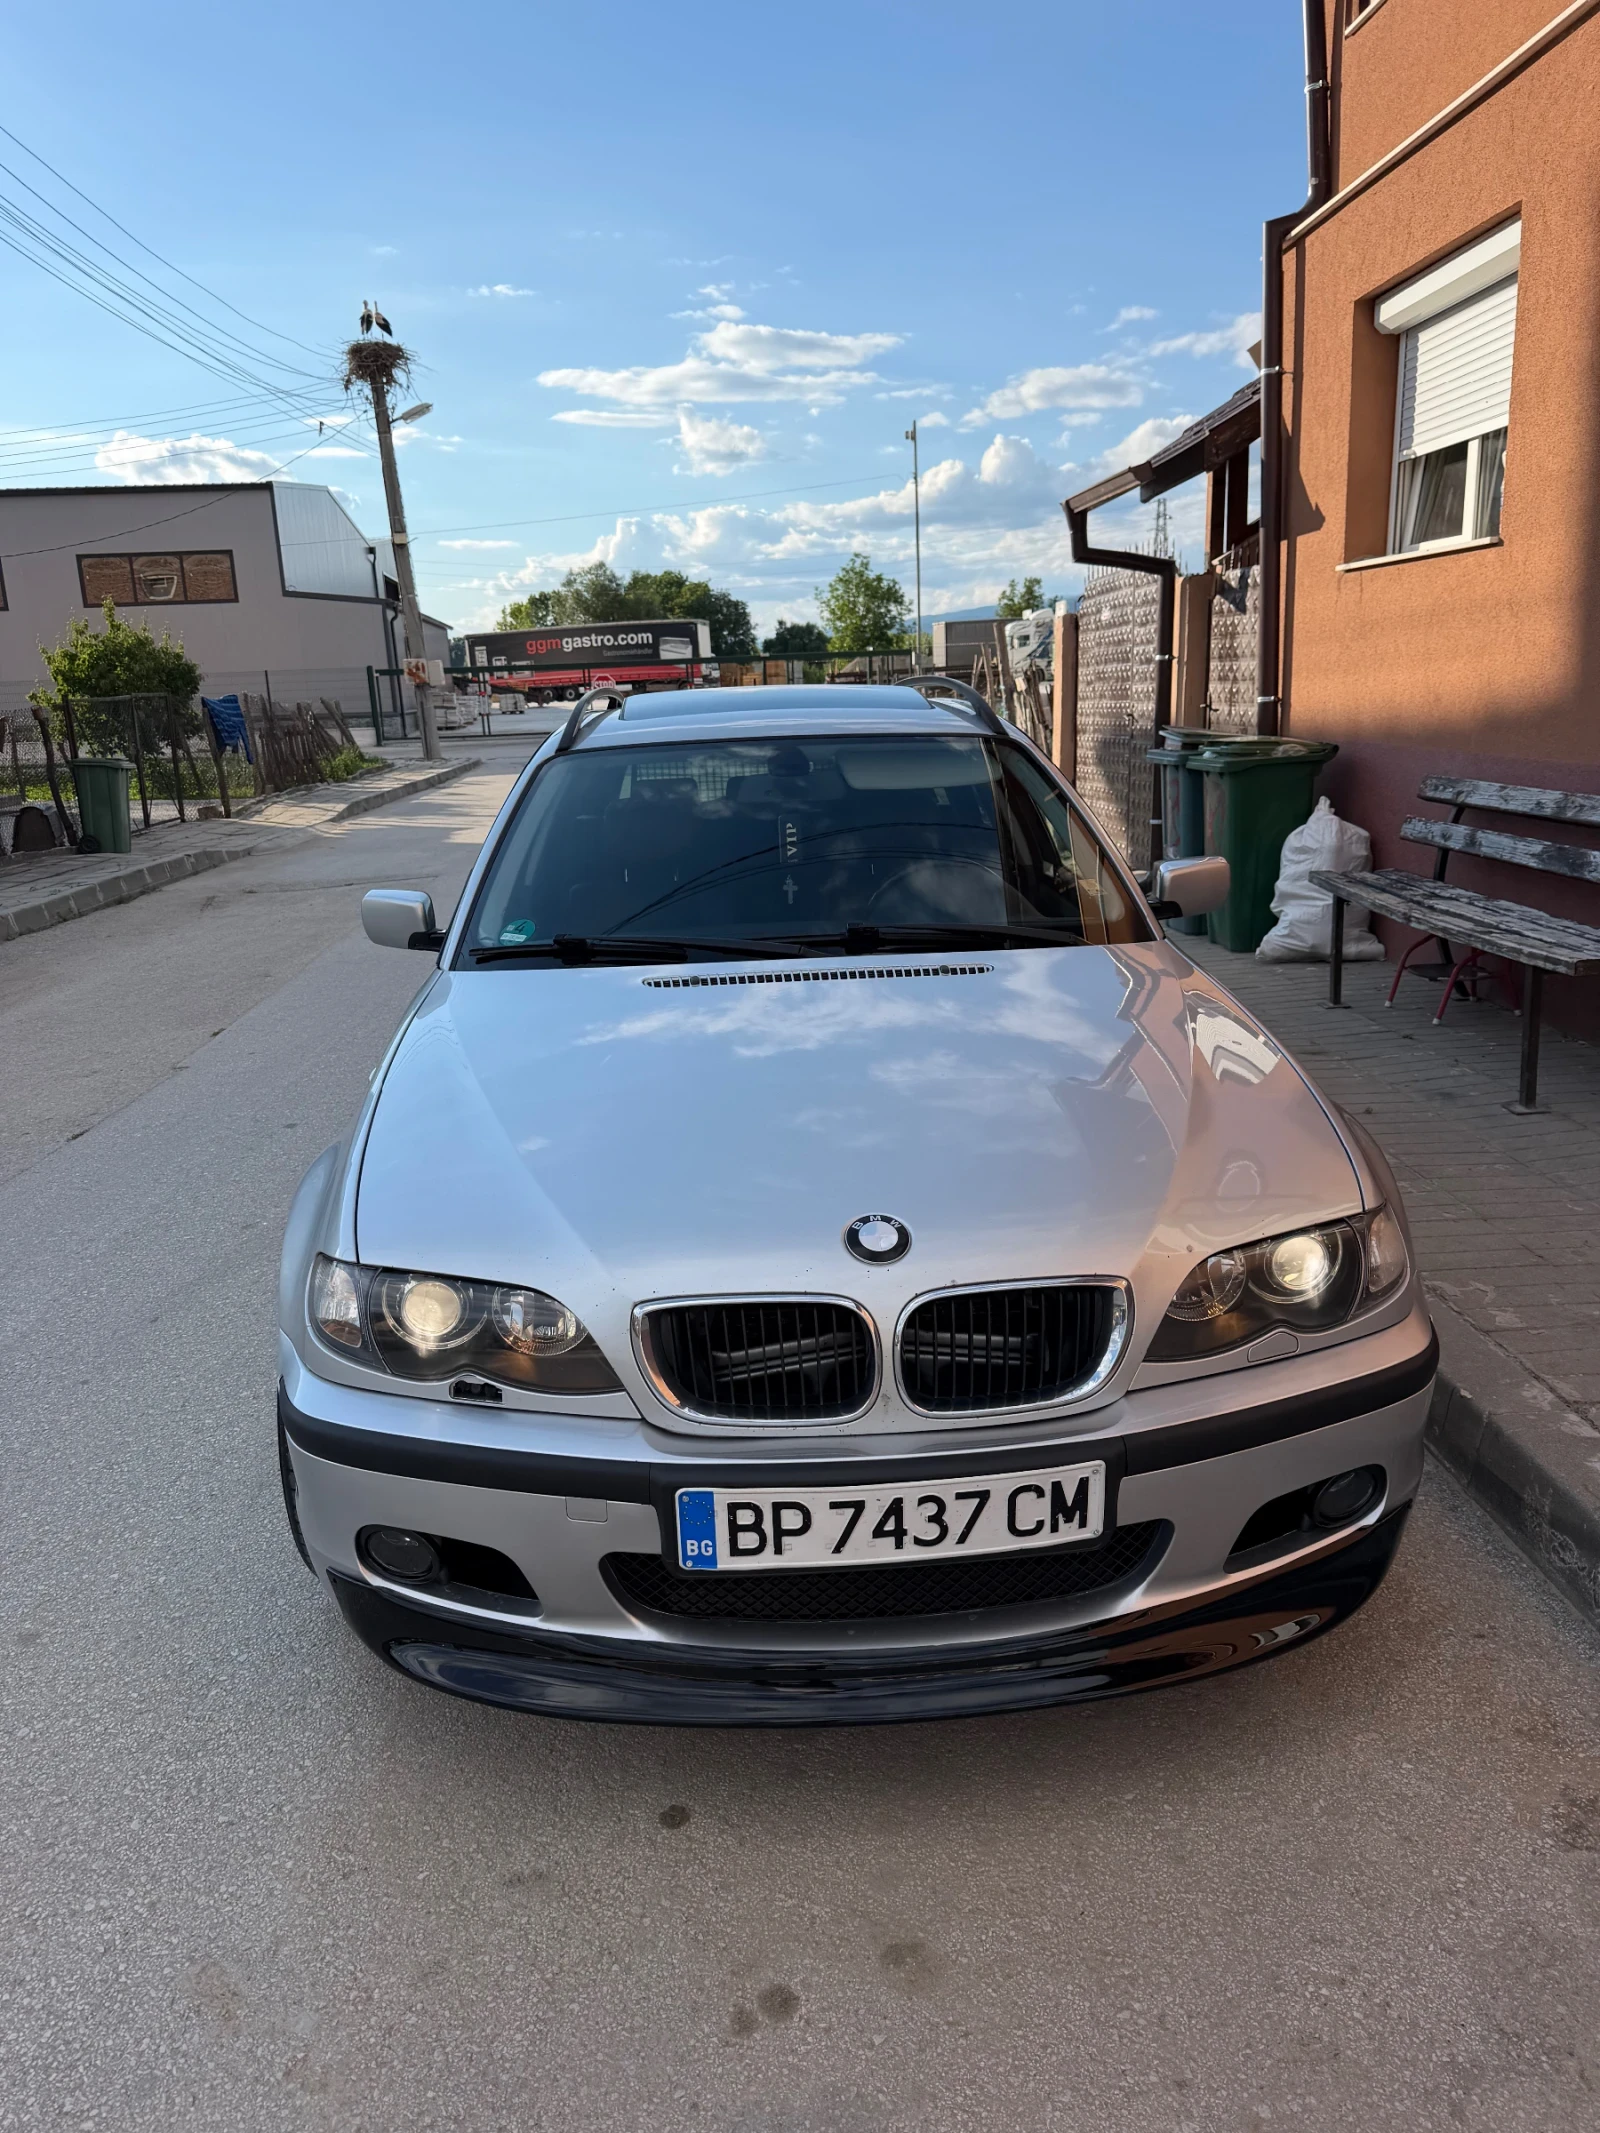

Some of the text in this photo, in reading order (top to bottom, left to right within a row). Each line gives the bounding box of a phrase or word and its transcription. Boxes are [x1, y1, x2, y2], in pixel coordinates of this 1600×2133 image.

[526, 632, 653, 654] ggmgastro.com
[594, 680, 614, 689] STOP
[786, 822, 798, 857] VIP
[851, 1215, 902, 1230] BMW
[727, 1475, 1090, 1557] BP 7437 CM
[686, 1539, 713, 1556] BG
